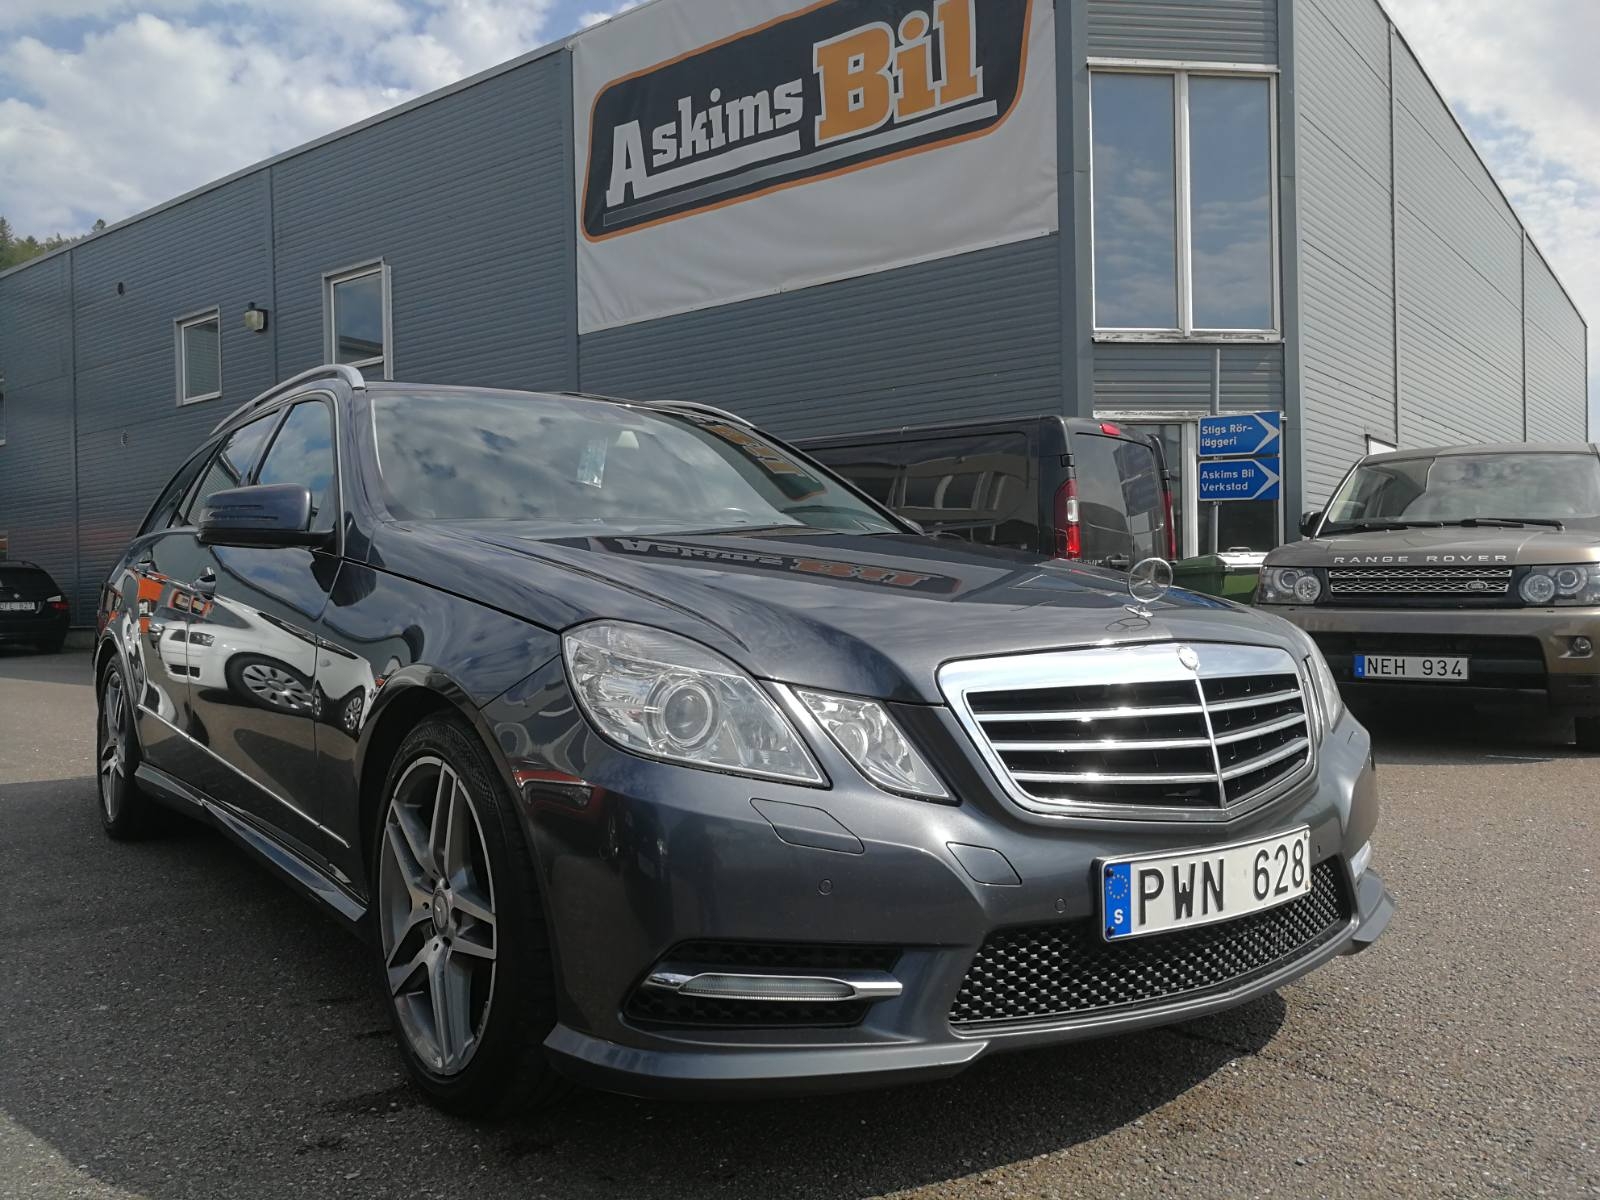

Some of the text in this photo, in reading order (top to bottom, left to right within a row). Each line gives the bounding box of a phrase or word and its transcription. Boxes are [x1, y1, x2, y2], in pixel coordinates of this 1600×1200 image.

[606, 0, 983, 207] Askims Bil
[1202, 423, 1253, 436] Stigs Rör-
[1201, 437, 1237, 448] läggeri
[1201, 469, 1254, 479] Askims Bil
[1201, 482, 1248, 491] Verkstad
[1334, 556, 1409, 564] RANGE
[1367, 658, 1463, 676] NEH 934
[1138, 838, 1305, 925] PWN 628
[1114, 909, 1124, 924] S
